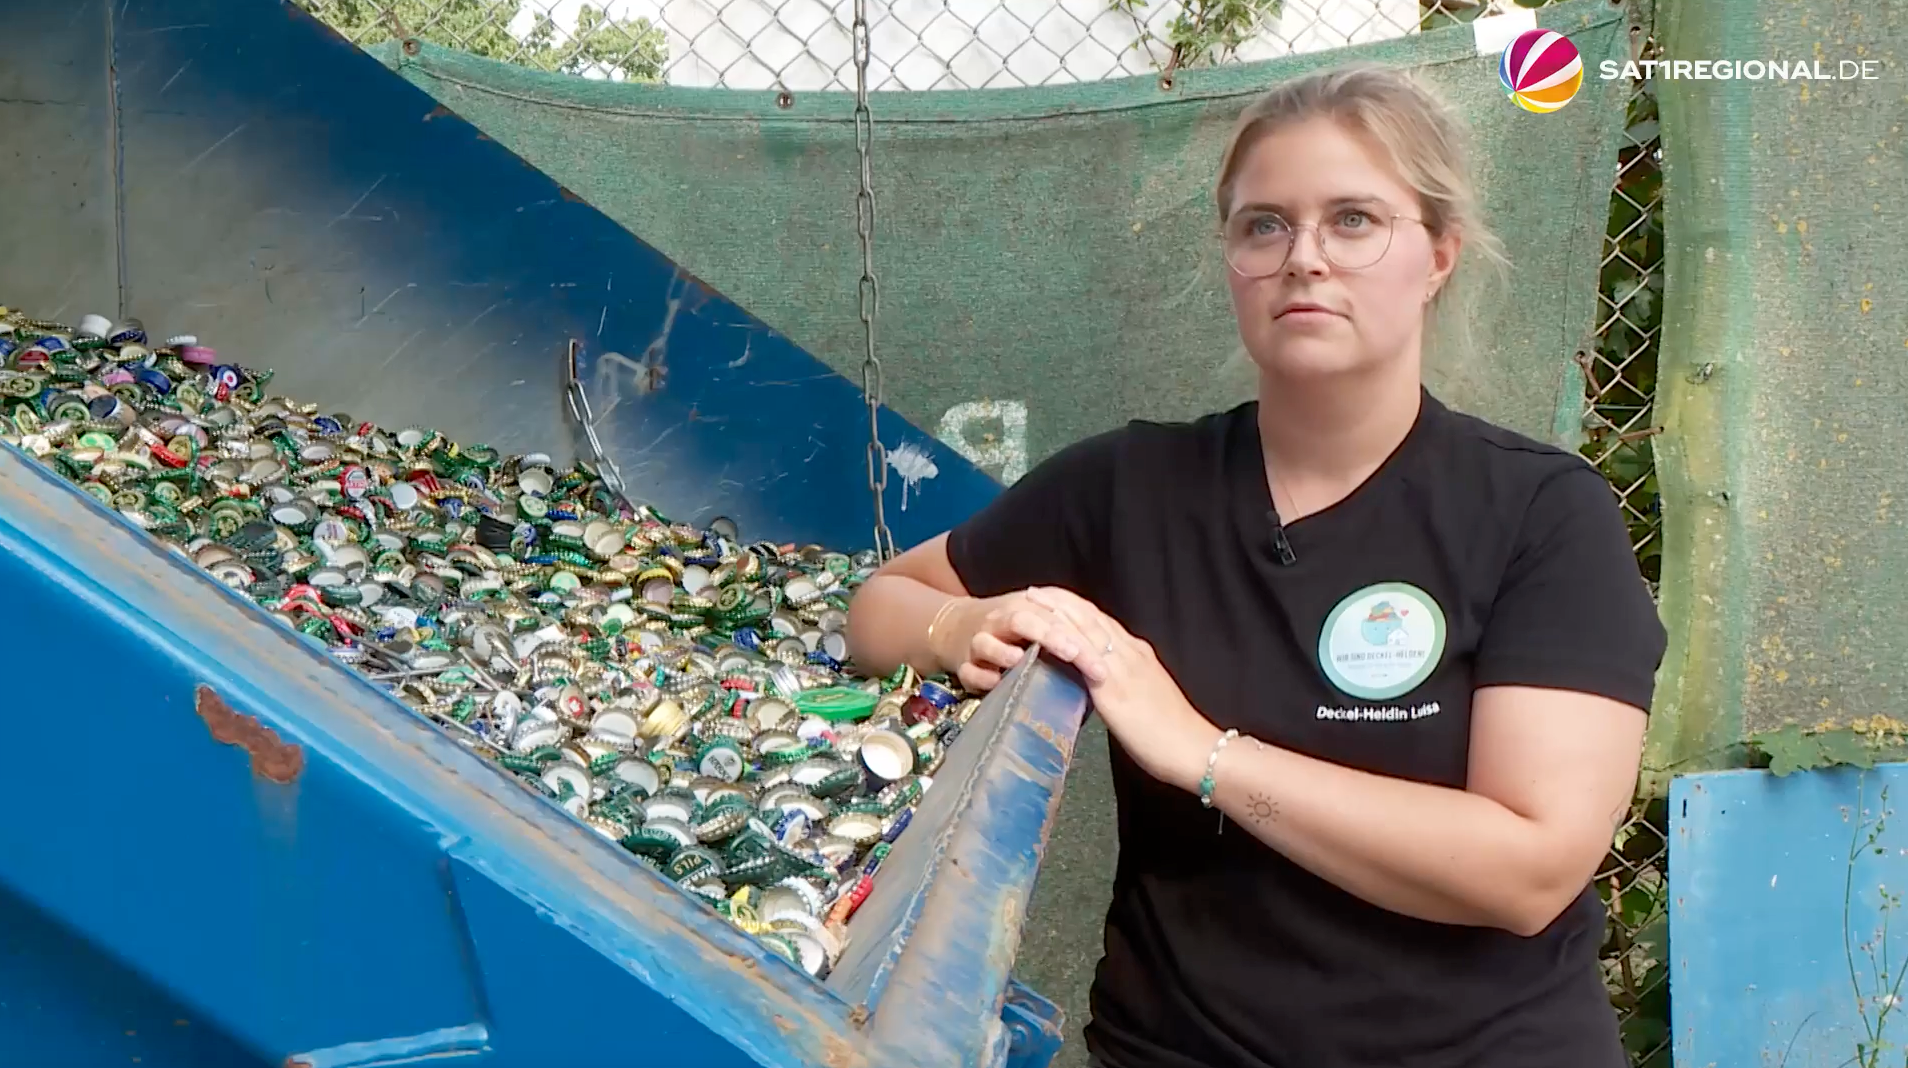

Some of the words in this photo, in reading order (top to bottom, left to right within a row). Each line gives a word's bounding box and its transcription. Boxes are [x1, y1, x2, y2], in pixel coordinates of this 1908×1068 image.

[1316, 705, 1408, 721] Deckel-Heldin
[1411, 701, 1440, 720] Luisa
[673, 854, 702, 875] PILS
